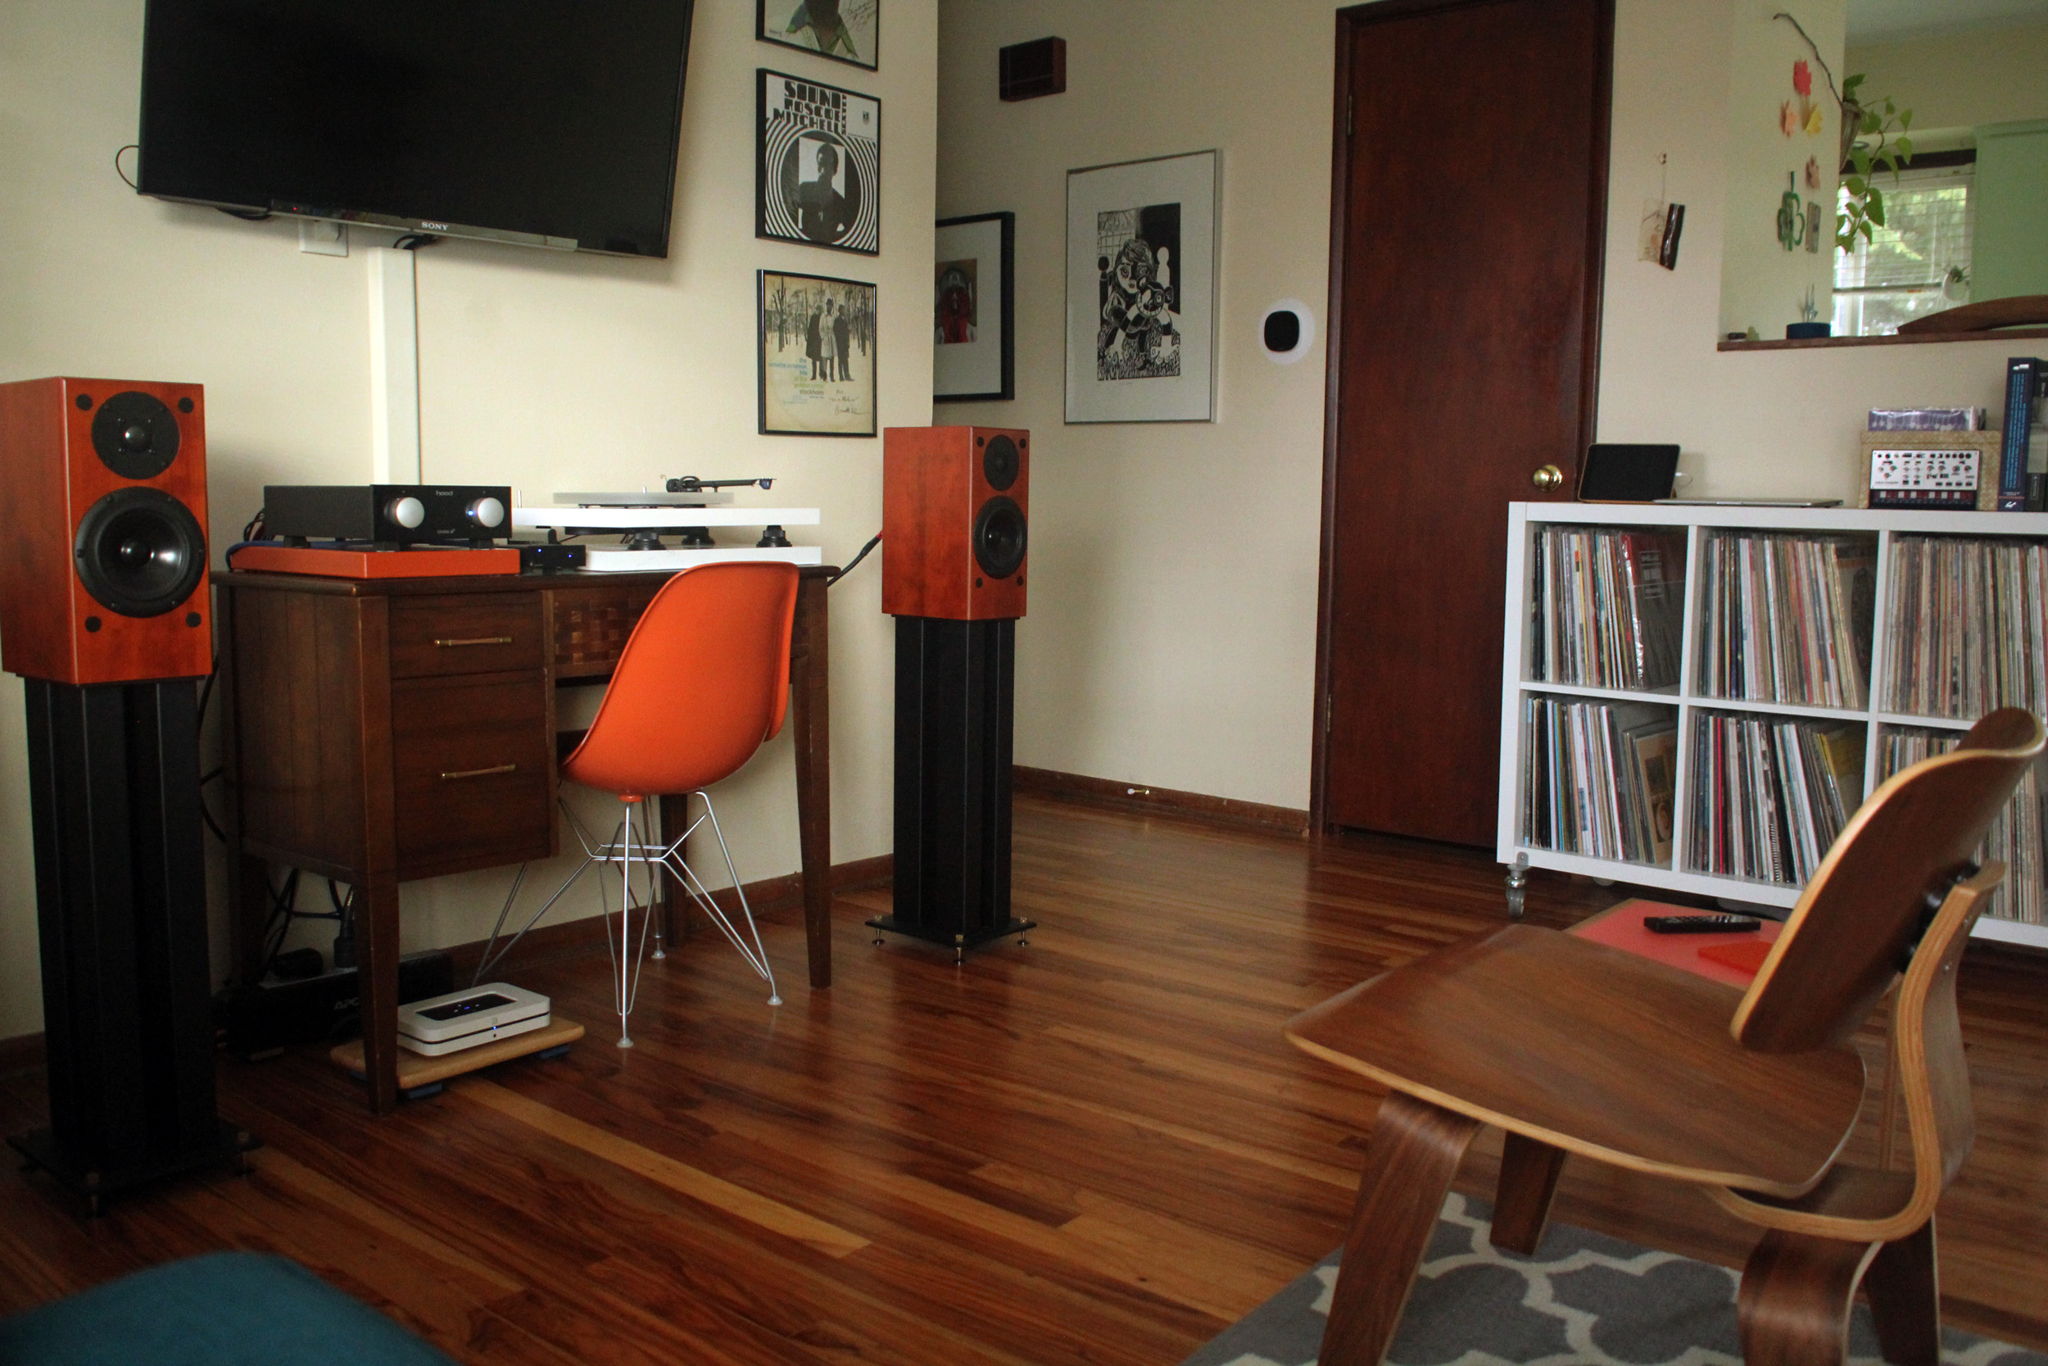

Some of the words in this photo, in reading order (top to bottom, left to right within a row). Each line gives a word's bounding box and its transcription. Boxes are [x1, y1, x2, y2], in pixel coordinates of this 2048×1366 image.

[773, 107, 841, 134] MITCHELL
[784, 97, 840, 123] ROSCOE
[421, 221, 448, 230] SONY
